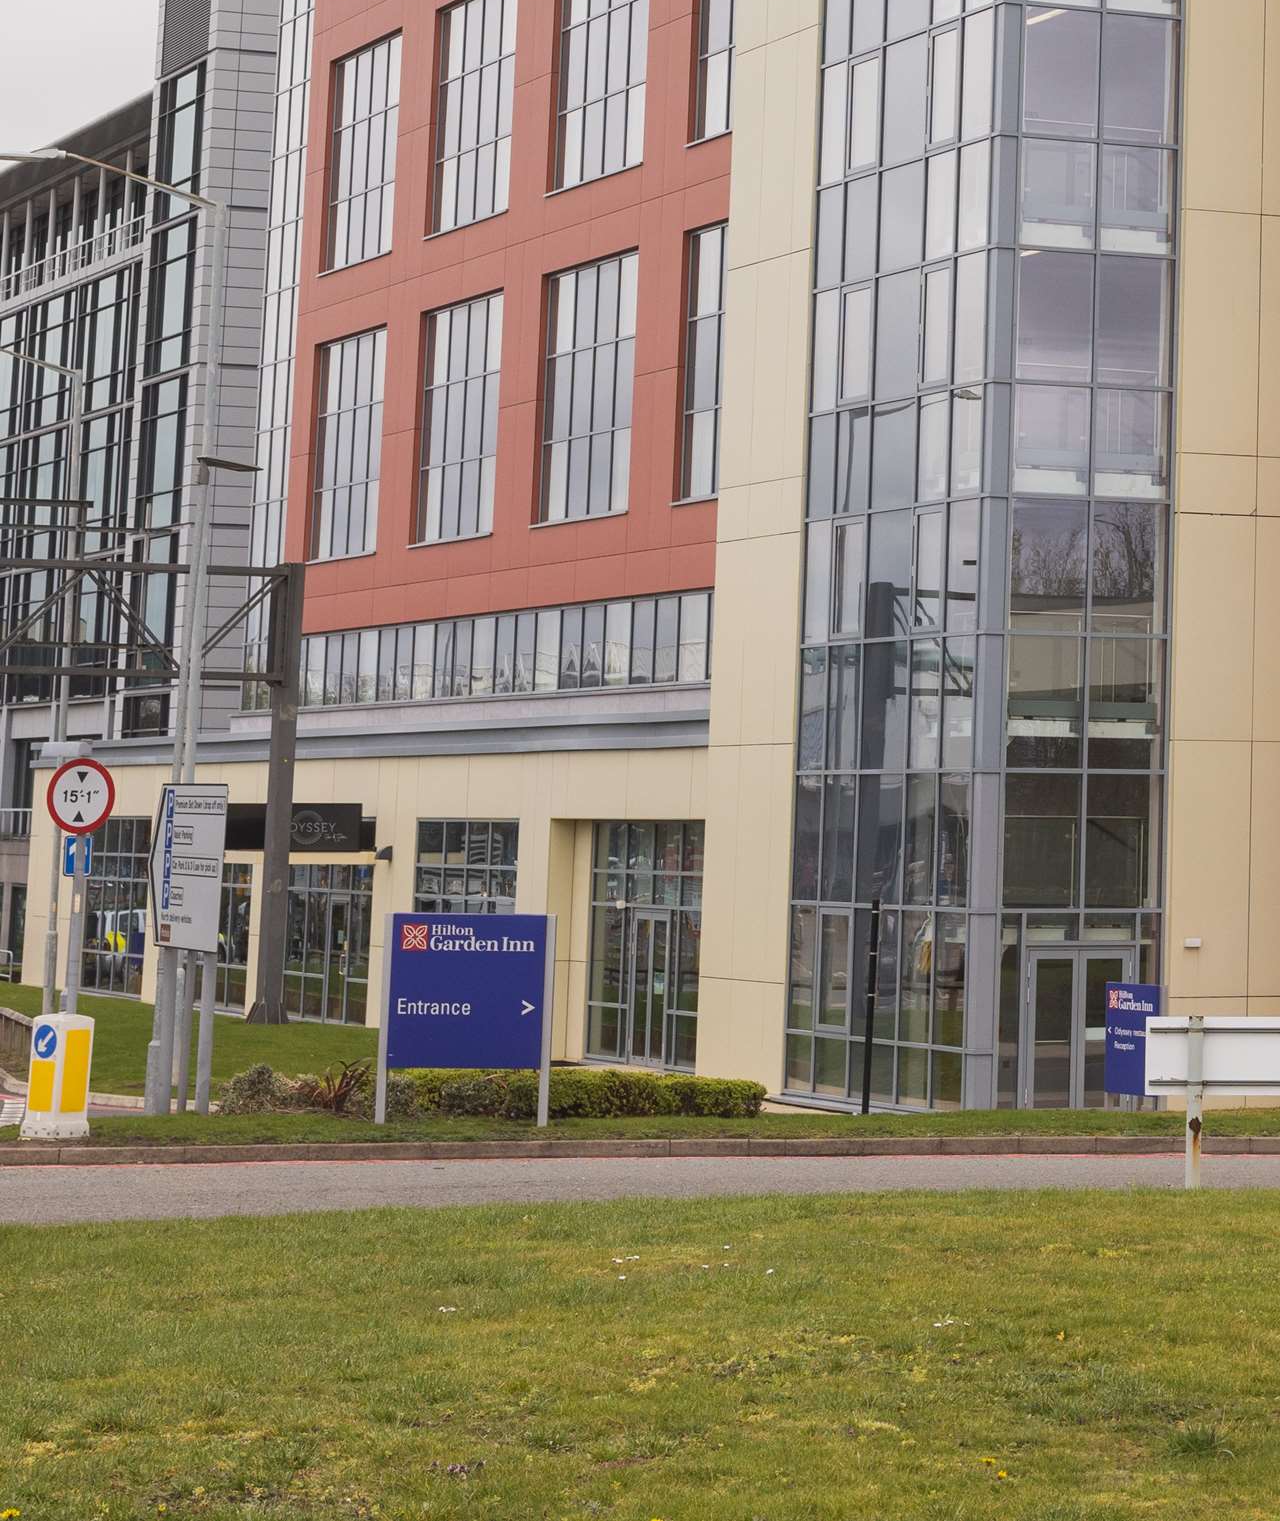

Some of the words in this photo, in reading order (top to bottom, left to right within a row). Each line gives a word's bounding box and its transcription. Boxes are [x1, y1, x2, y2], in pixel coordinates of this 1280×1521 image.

[290, 822, 336, 833] DYSSEY
[431, 924, 473, 935] Hilton
[430, 936, 498, 951] Garden
[501, 937, 535, 952] Inn
[1119, 990, 1133, 999] Hilton
[397, 998, 471, 1015] Entrance
[1118, 999, 1141, 1011] Garden
[1141, 1000, 1153, 1012] Inn
[1113, 1040, 1135, 1051] Reception
